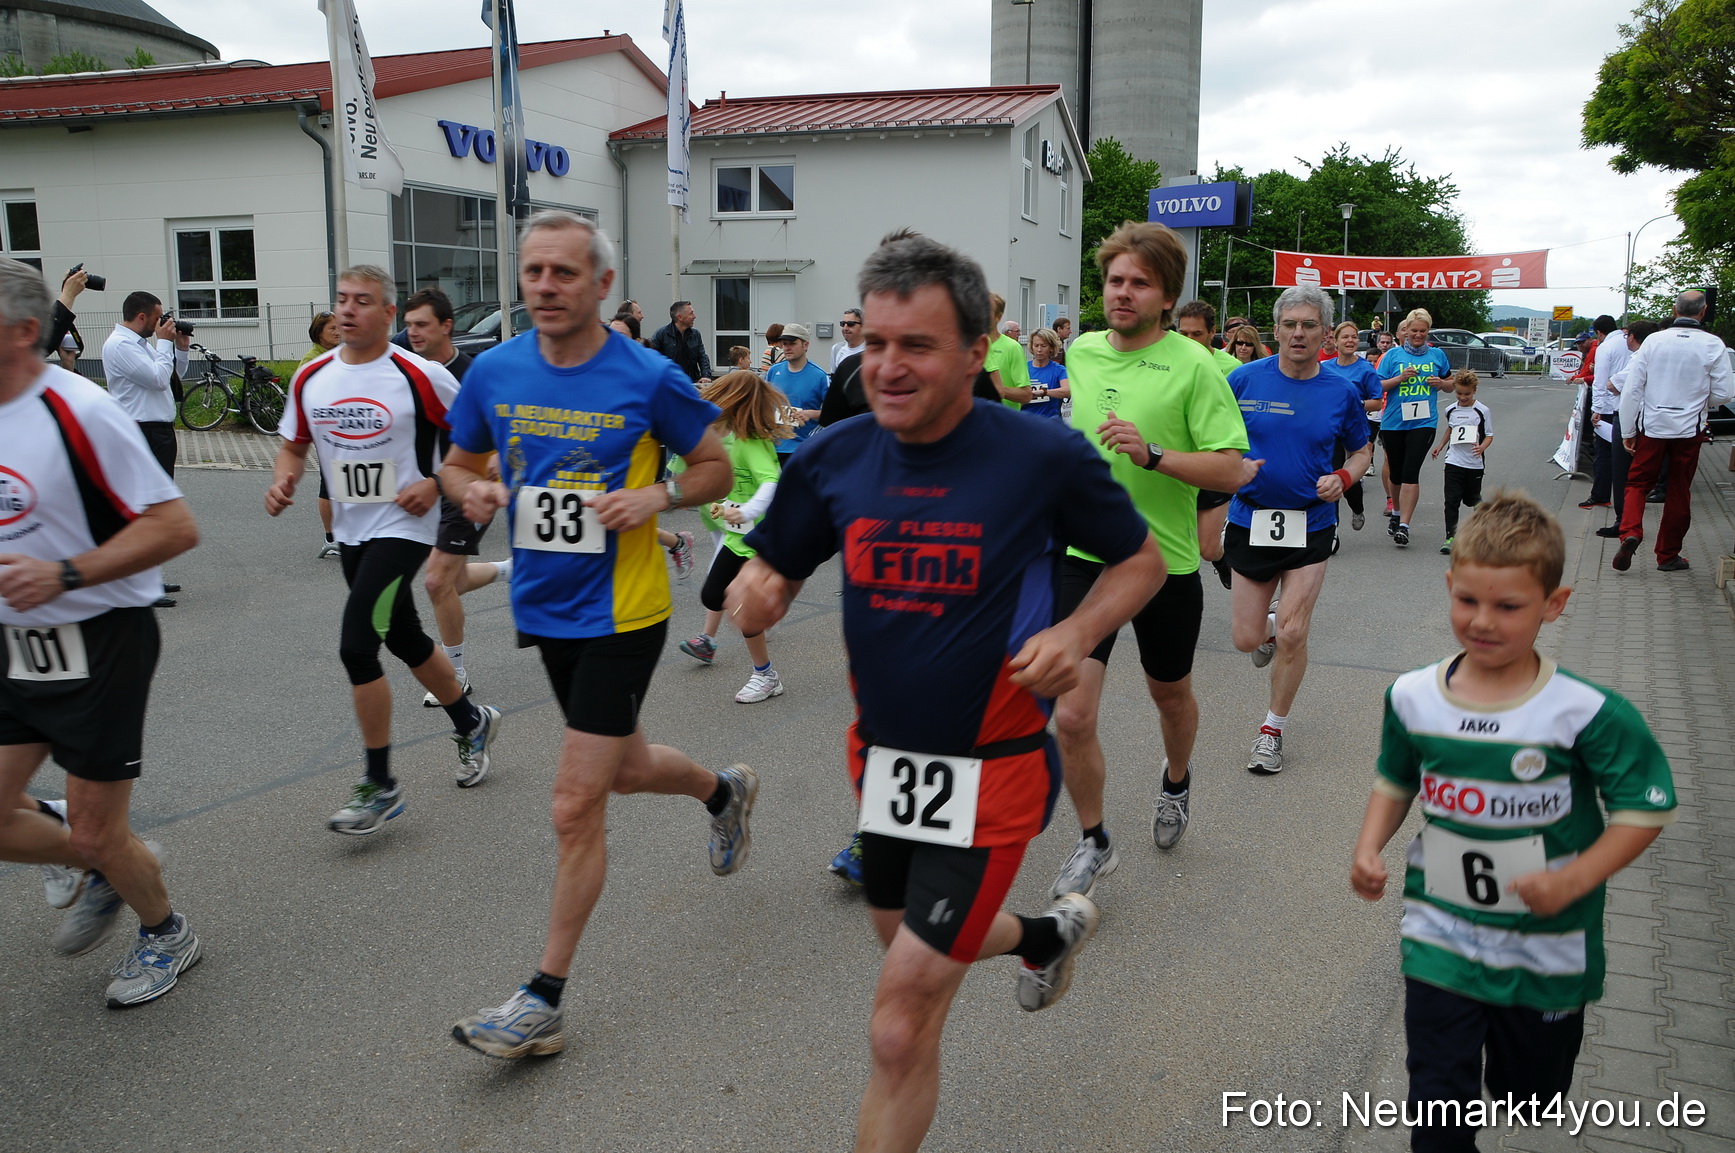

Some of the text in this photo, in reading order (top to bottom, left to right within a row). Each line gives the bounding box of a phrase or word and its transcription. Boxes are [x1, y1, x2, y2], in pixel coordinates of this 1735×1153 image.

[360, 122, 378, 160] Neu
[437, 120, 570, 177] VOVO
[358, 172, 376, 180] ARS.DE
[1156, 195, 1222, 215] VOLVO
[1398, 386, 1431, 397] RUN
[312, 407, 375, 419] GERHART
[513, 404, 626, 429] NEUMARKTER
[1411, 403, 1419, 417] 7
[338, 419, 384, 430] JANIG
[510, 419, 601, 442] STADTLAUF
[1458, 427, 1466, 441] 2
[342, 463, 383, 498] 107
[535, 491, 583, 545] 33
[899, 520, 983, 539] FLIESEN
[1269, 511, 1286, 541] 3
[872, 545, 974, 587] Fink
[14, 628, 69, 675] 101
[1459, 718, 1500, 734] JAKO
[890, 757, 954, 830] 32
[1490, 792, 1561, 819] Direkt
[1461, 850, 1500, 906] 6
